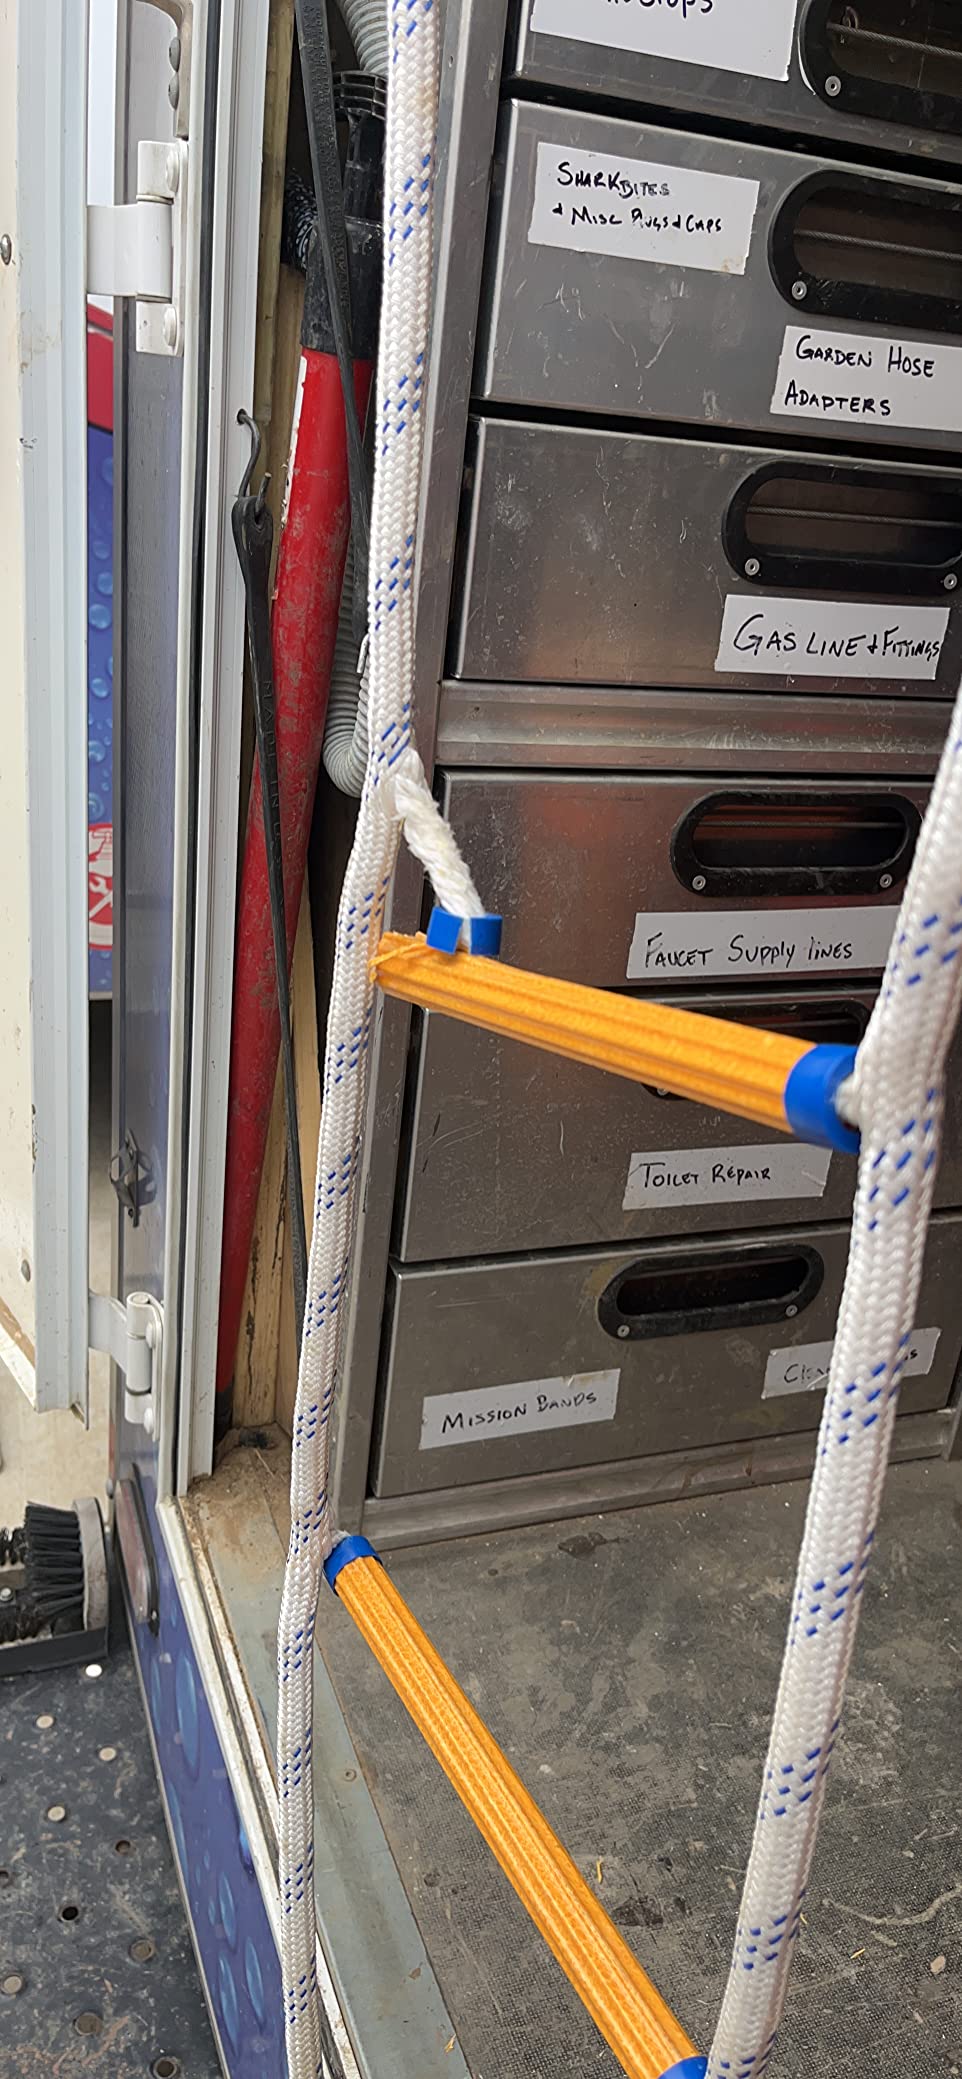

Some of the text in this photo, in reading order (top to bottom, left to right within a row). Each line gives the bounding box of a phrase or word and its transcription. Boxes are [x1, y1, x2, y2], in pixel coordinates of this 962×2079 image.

[796, 335, 935, 378] GARDEN HOSE
[784, 380, 891, 417] ADAPTERS
[733, 614, 796, 656] GAS
[806, 631, 866, 657] LINE
[645, 932, 713, 968] FAUCET
[441, 1403, 528, 1433] MISSION
